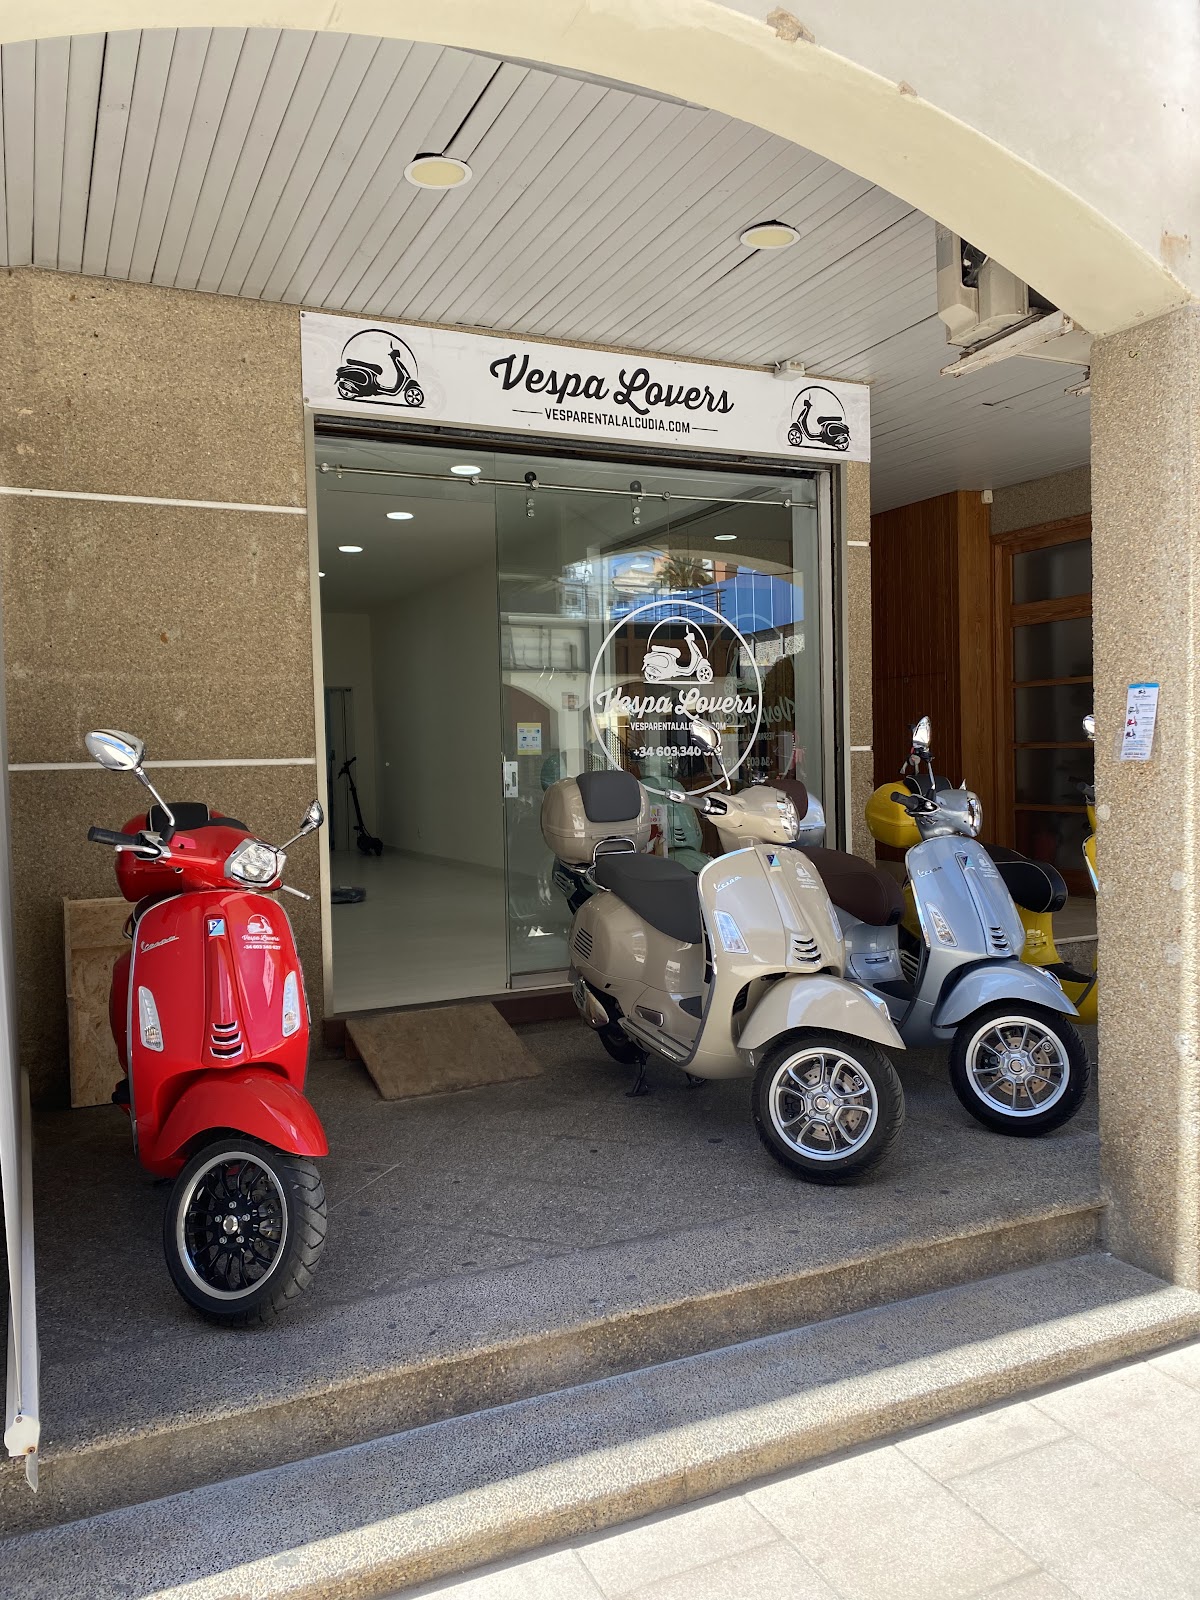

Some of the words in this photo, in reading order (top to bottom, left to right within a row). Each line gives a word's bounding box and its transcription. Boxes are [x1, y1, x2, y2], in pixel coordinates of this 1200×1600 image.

[490, 354, 609, 404] Vespa
[613, 368, 734, 415] Lovers
[545, 408, 690, 433] VESPARENTALALCUDIA.COM
[596, 687, 673, 718] Vespa
[675, 688, 756, 720] Lovers
[633, 746, 655, 758] +34
[656, 746, 678, 757] 603
[679, 746, 702, 757] 340
